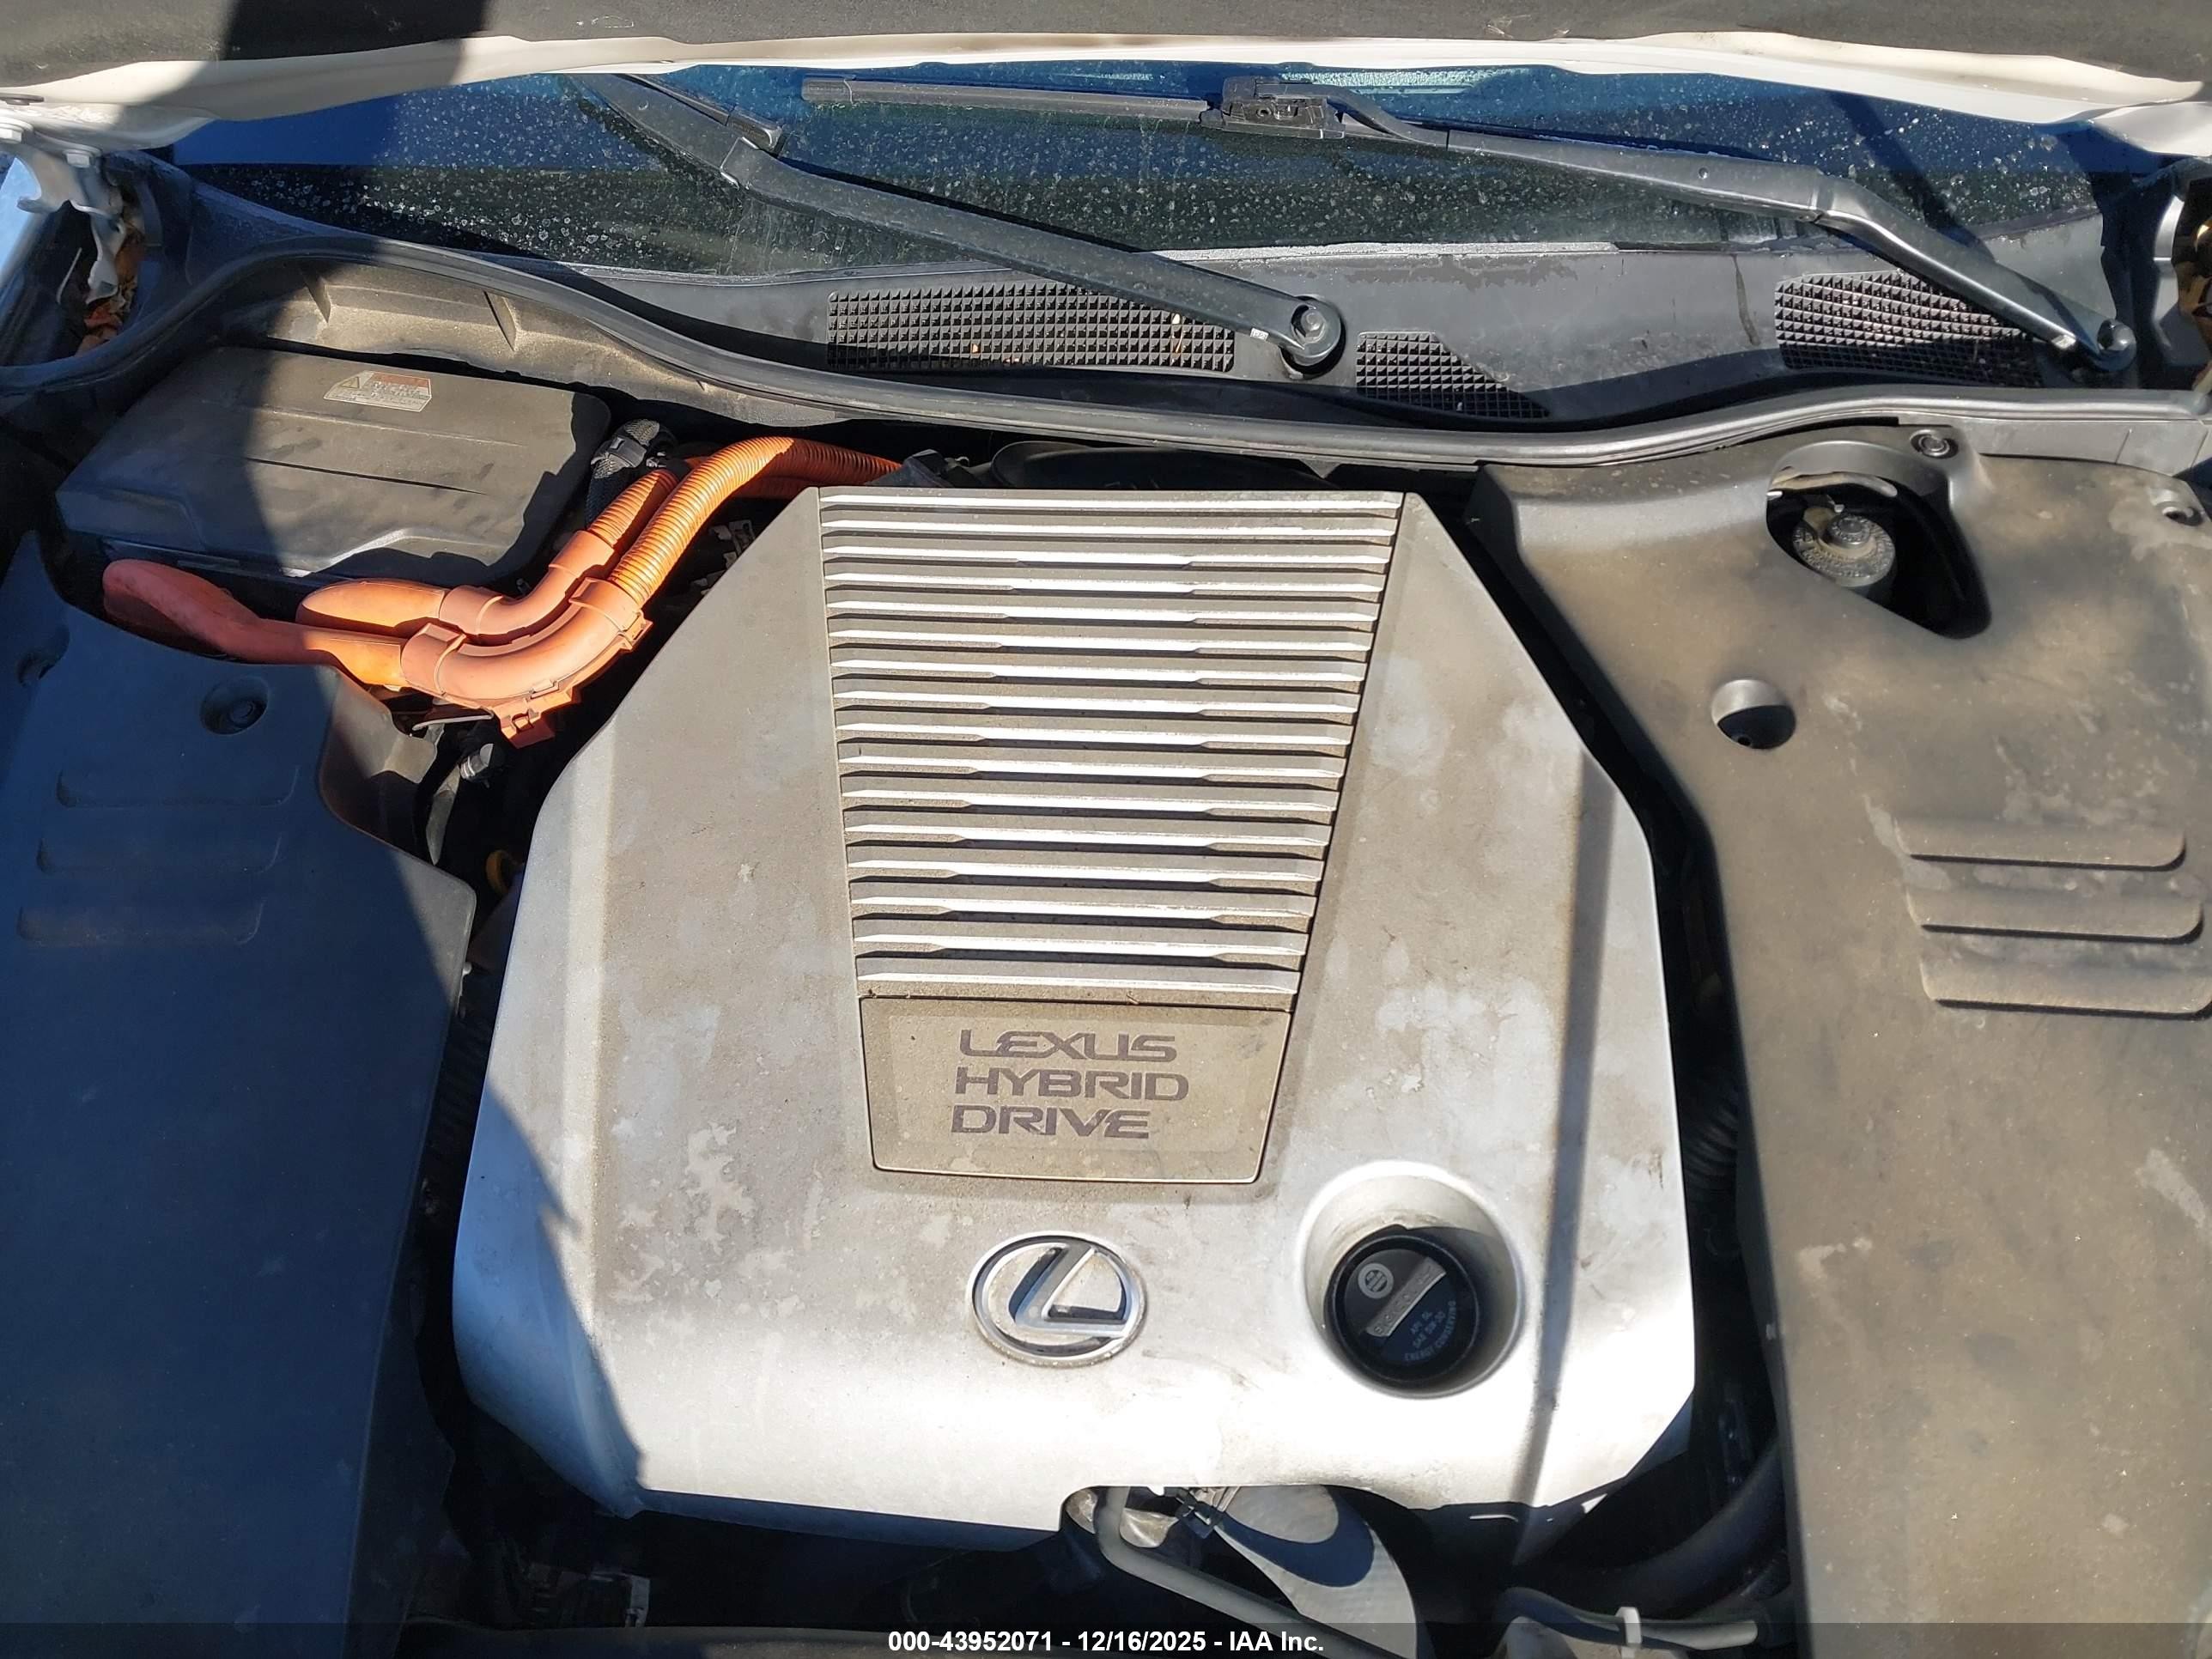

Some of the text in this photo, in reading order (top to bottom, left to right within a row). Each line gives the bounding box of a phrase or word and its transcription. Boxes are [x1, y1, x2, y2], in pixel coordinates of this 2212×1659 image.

[959, 1029, 1177, 1063] LEXUS
[955, 1066, 1189, 1101] HYBRID
[951, 1104, 1151, 1139] DRIVE
